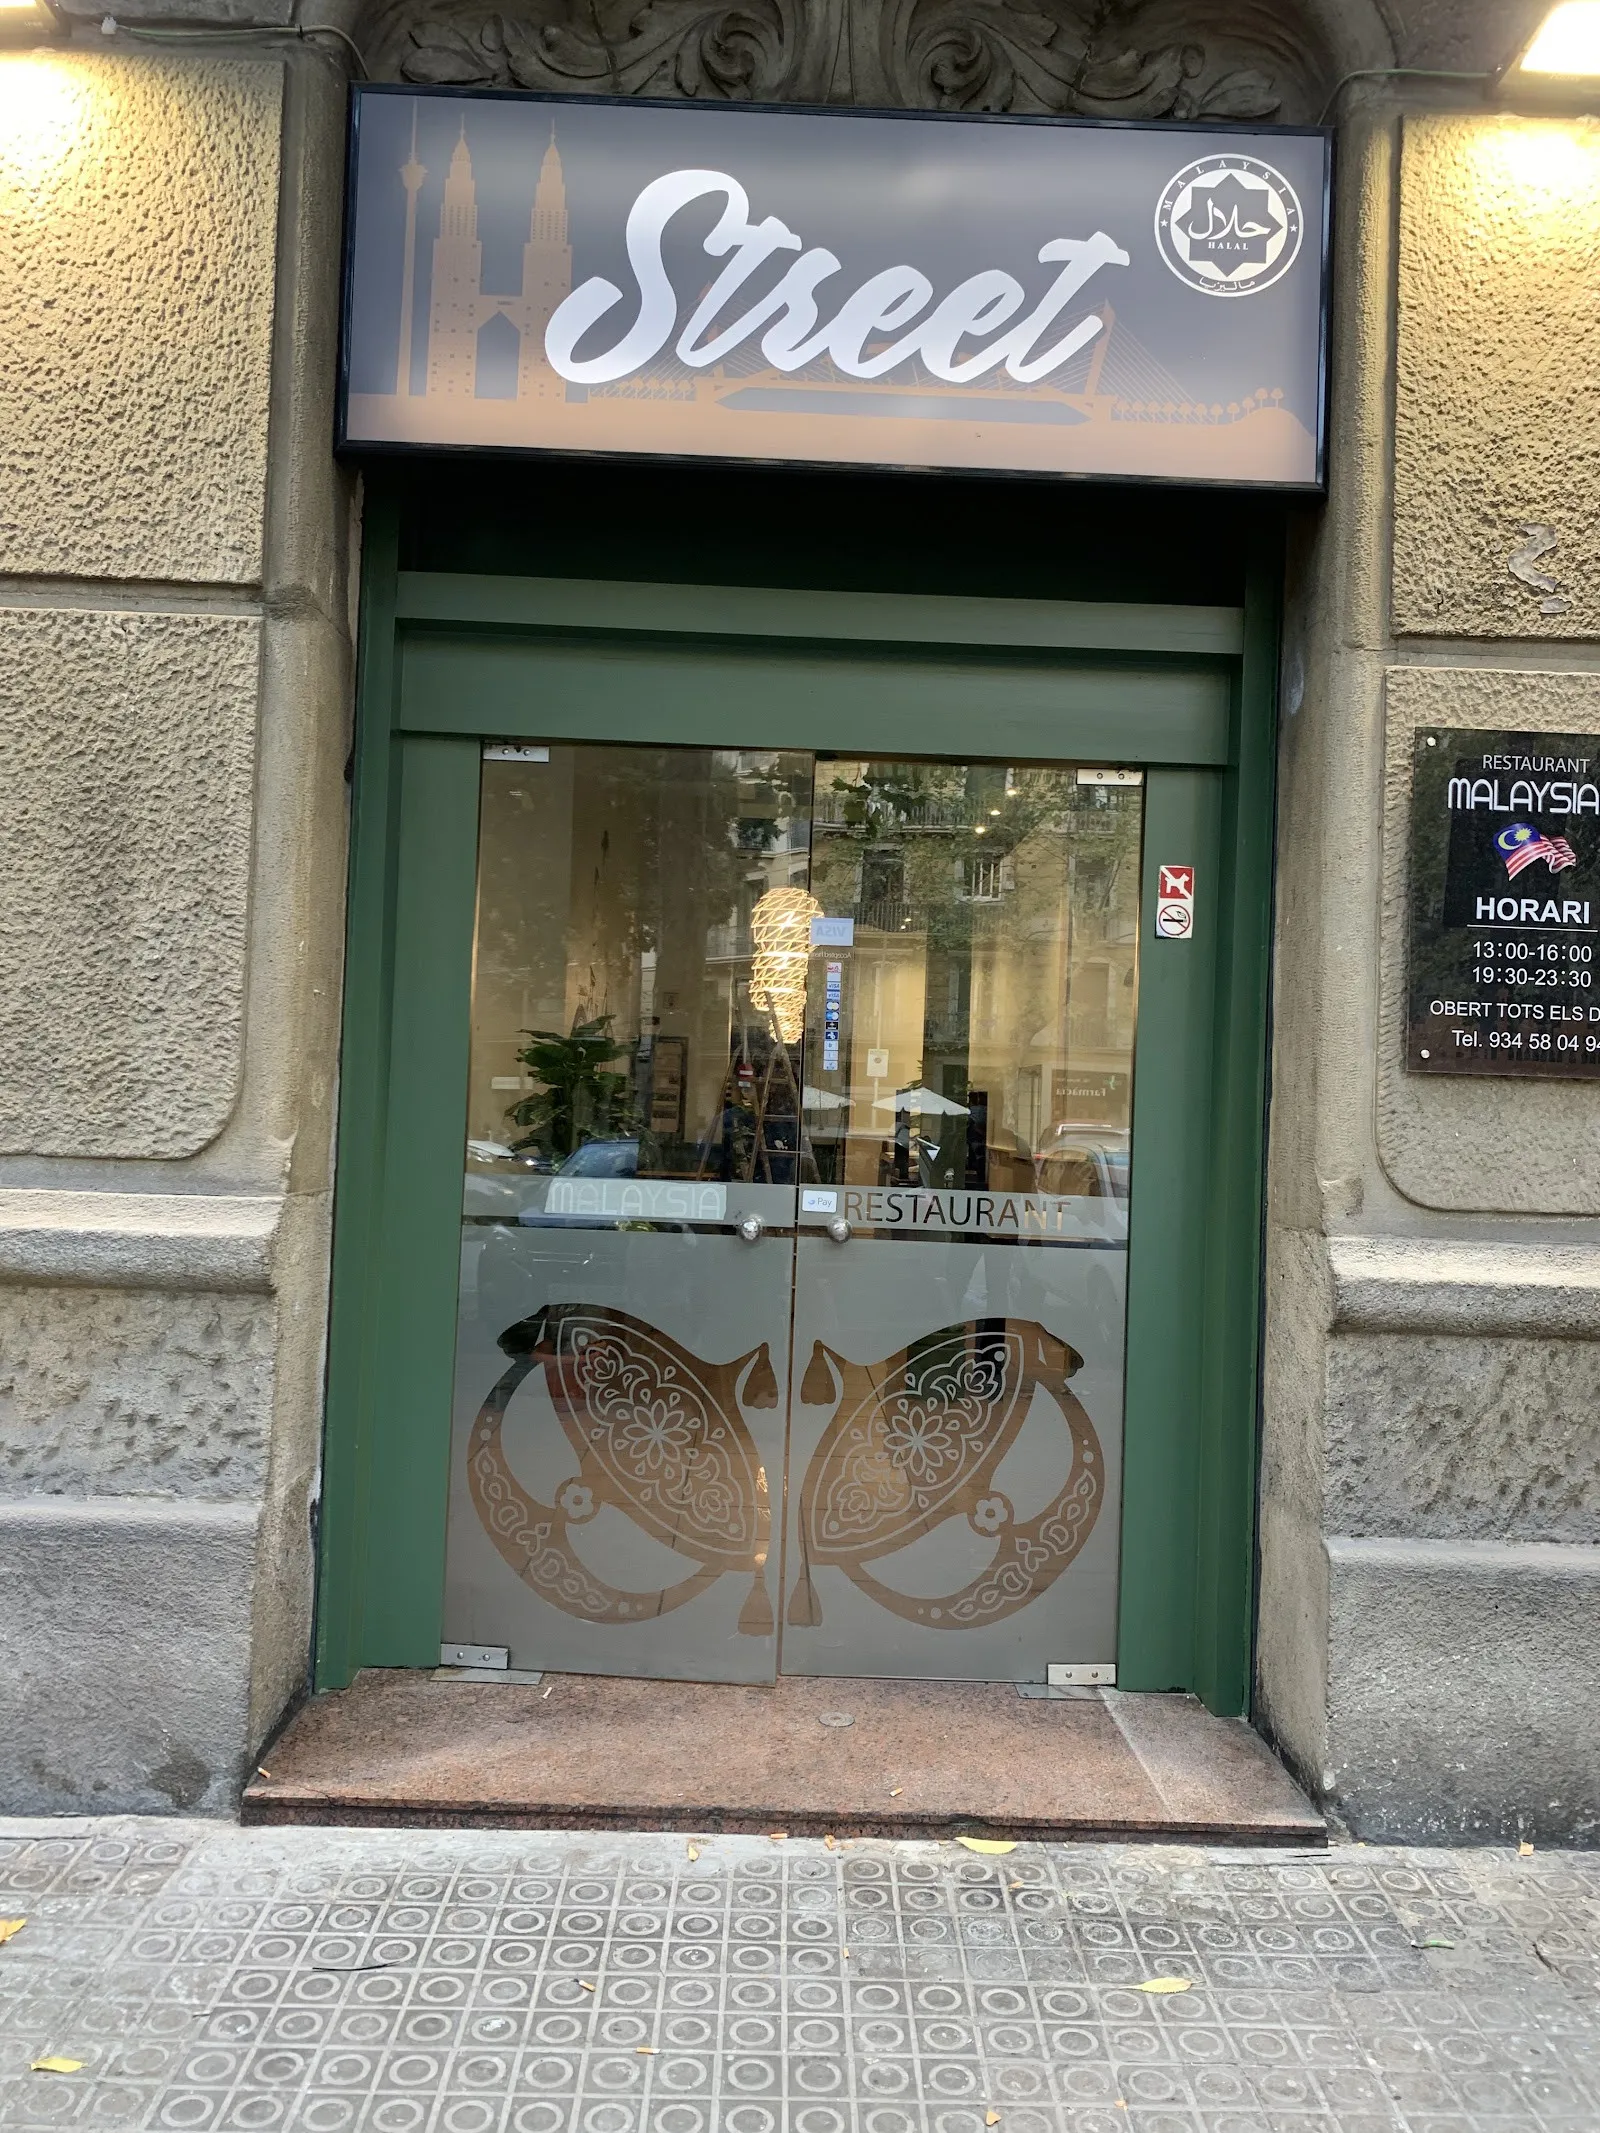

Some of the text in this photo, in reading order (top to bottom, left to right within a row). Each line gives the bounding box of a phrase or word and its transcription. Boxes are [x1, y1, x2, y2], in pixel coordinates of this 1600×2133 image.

[1163, 160, 1296, 216] MALAYSIA
[1188, 197, 1272, 240] حلال
[1207, 241, 1249, 251] HALAL
[545, 169, 1130, 384] Street
[1482, 754, 1590, 774] RESTAURANT
[1447, 777, 1600, 815] MALAYSIA
[1475, 896, 1590, 924] HORARI
[1472, 941, 1592, 963] 13:00-16:00
[1472, 966, 1592, 988] 19:30-23:30
[1429, 1000, 1493, 1018] OBERT
[1496, 1003, 1545, 1020] TOTS
[1549, 1005, 1584, 1021] ELS
[1451, 1029, 1483, 1048] Tel.
[1489, 1031, 1523, 1049] 934
[1528, 1033, 1551, 1050] 58
[1556, 1034, 1580, 1051] 04
[550, 1181, 721, 1220] MALAYSIA
[817, 1197, 832, 1208] Pay
[844, 1191, 1072, 1232] RESTAURANT
